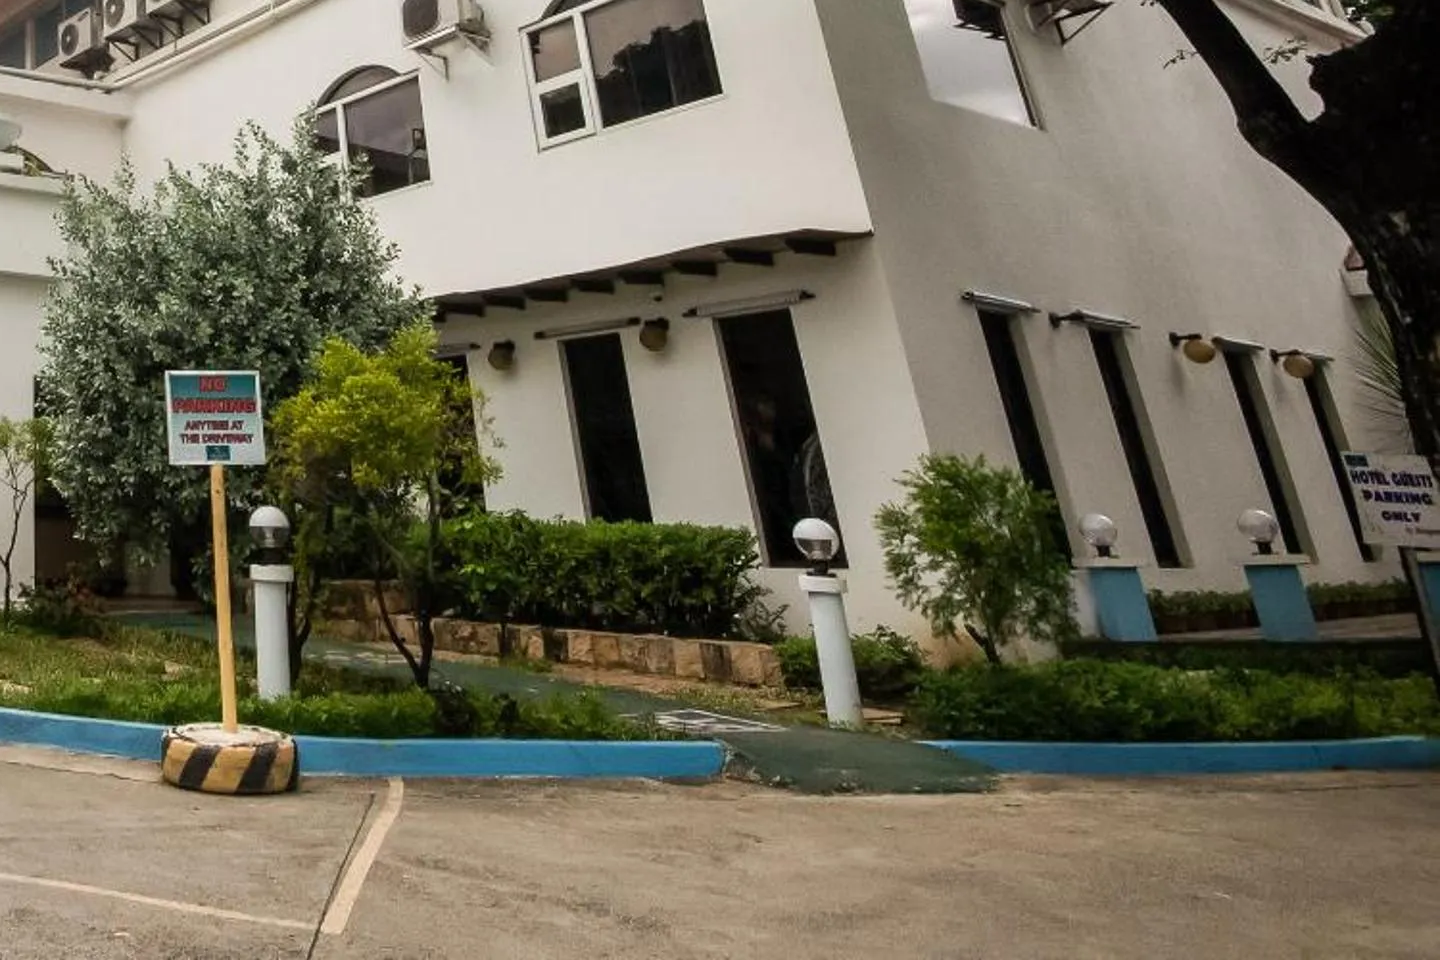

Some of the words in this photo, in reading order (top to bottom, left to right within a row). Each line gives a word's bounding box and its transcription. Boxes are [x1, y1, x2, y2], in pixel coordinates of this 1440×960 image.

[197, 375, 226, 392] NO
[171, 397, 257, 414] PARKING
[231, 420, 244, 431] AT
[180, 433, 200, 445] THE
[201, 433, 254, 445] DRIVEWAY
[1350, 469, 1391, 487] HOTEL
[1362, 489, 1433, 506] PARKING
[1381, 511, 1421, 523] ONLY
